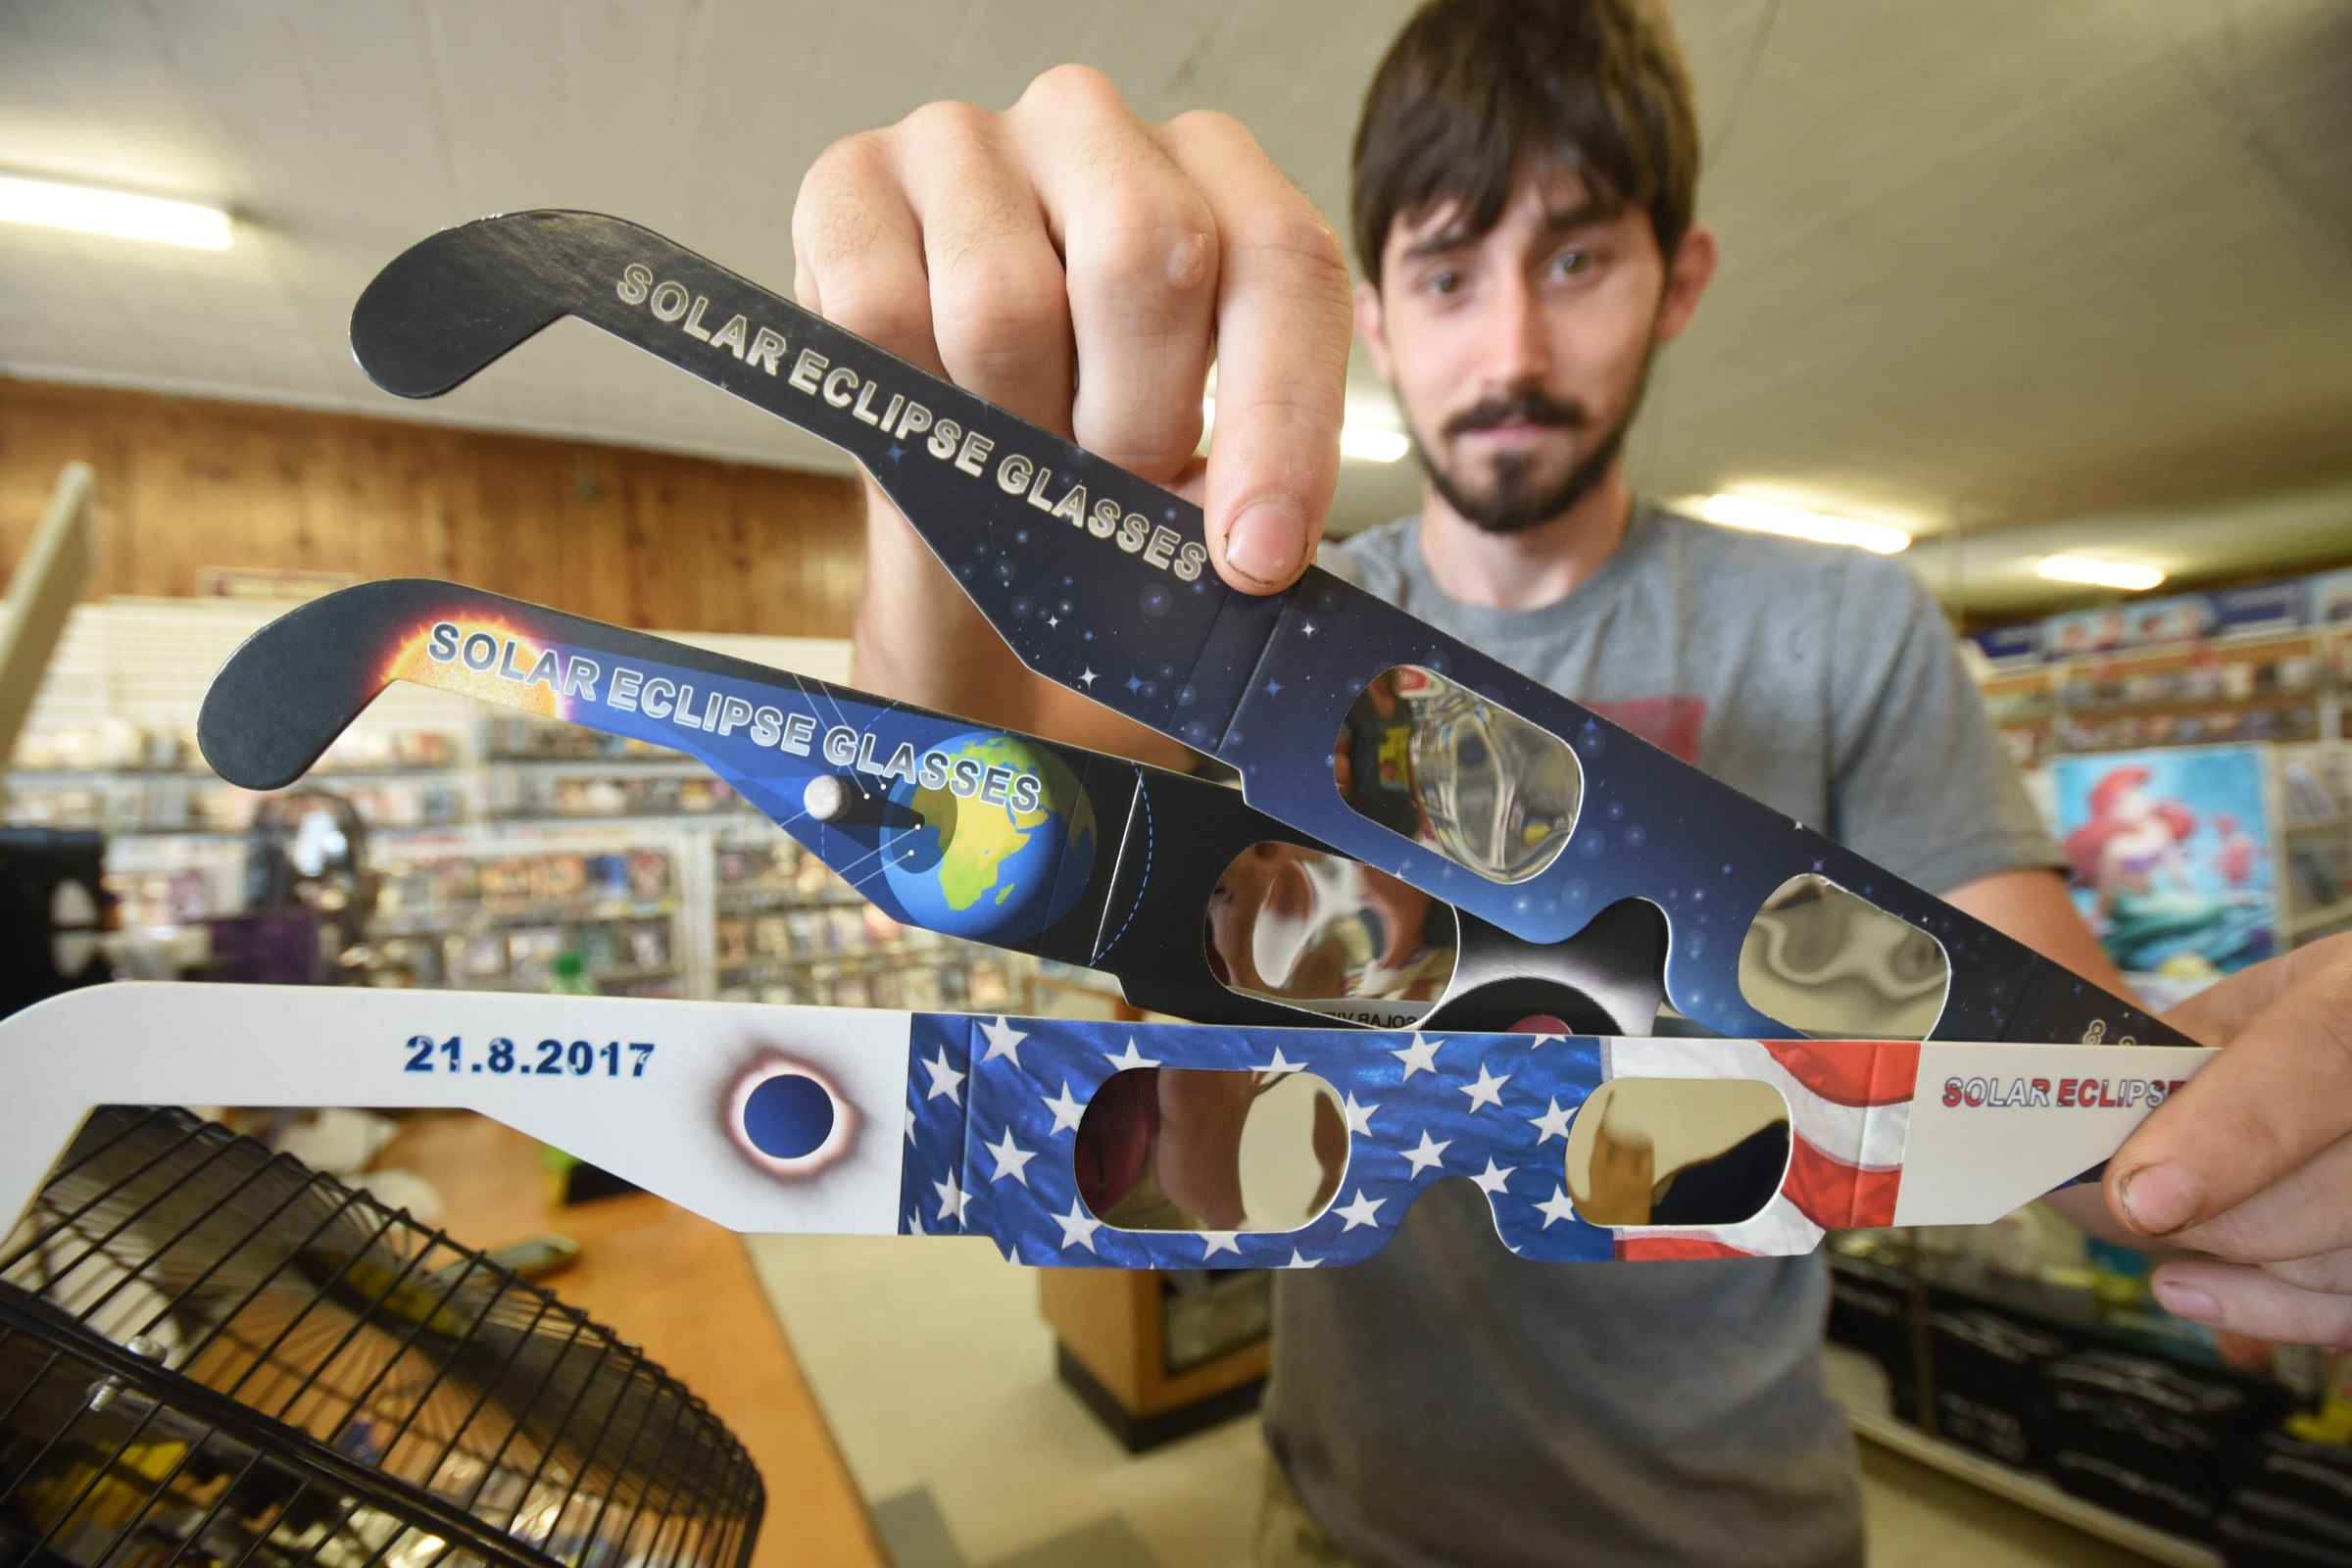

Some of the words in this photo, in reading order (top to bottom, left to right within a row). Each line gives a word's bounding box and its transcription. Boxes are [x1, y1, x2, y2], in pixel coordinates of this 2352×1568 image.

[616, 263, 786, 376] SOLAR
[788, 348, 995, 477] ECLIPSE
[997, 454, 1207, 582] GLASSES
[427, 621, 600, 702] SOLAR
[607, 666, 816, 757] ECLIPSE
[822, 725, 1042, 813] GLASSES
[404, 1035, 656, 1078] 21.8.2017
[1942, 1077, 2051, 1107] SOLAR
